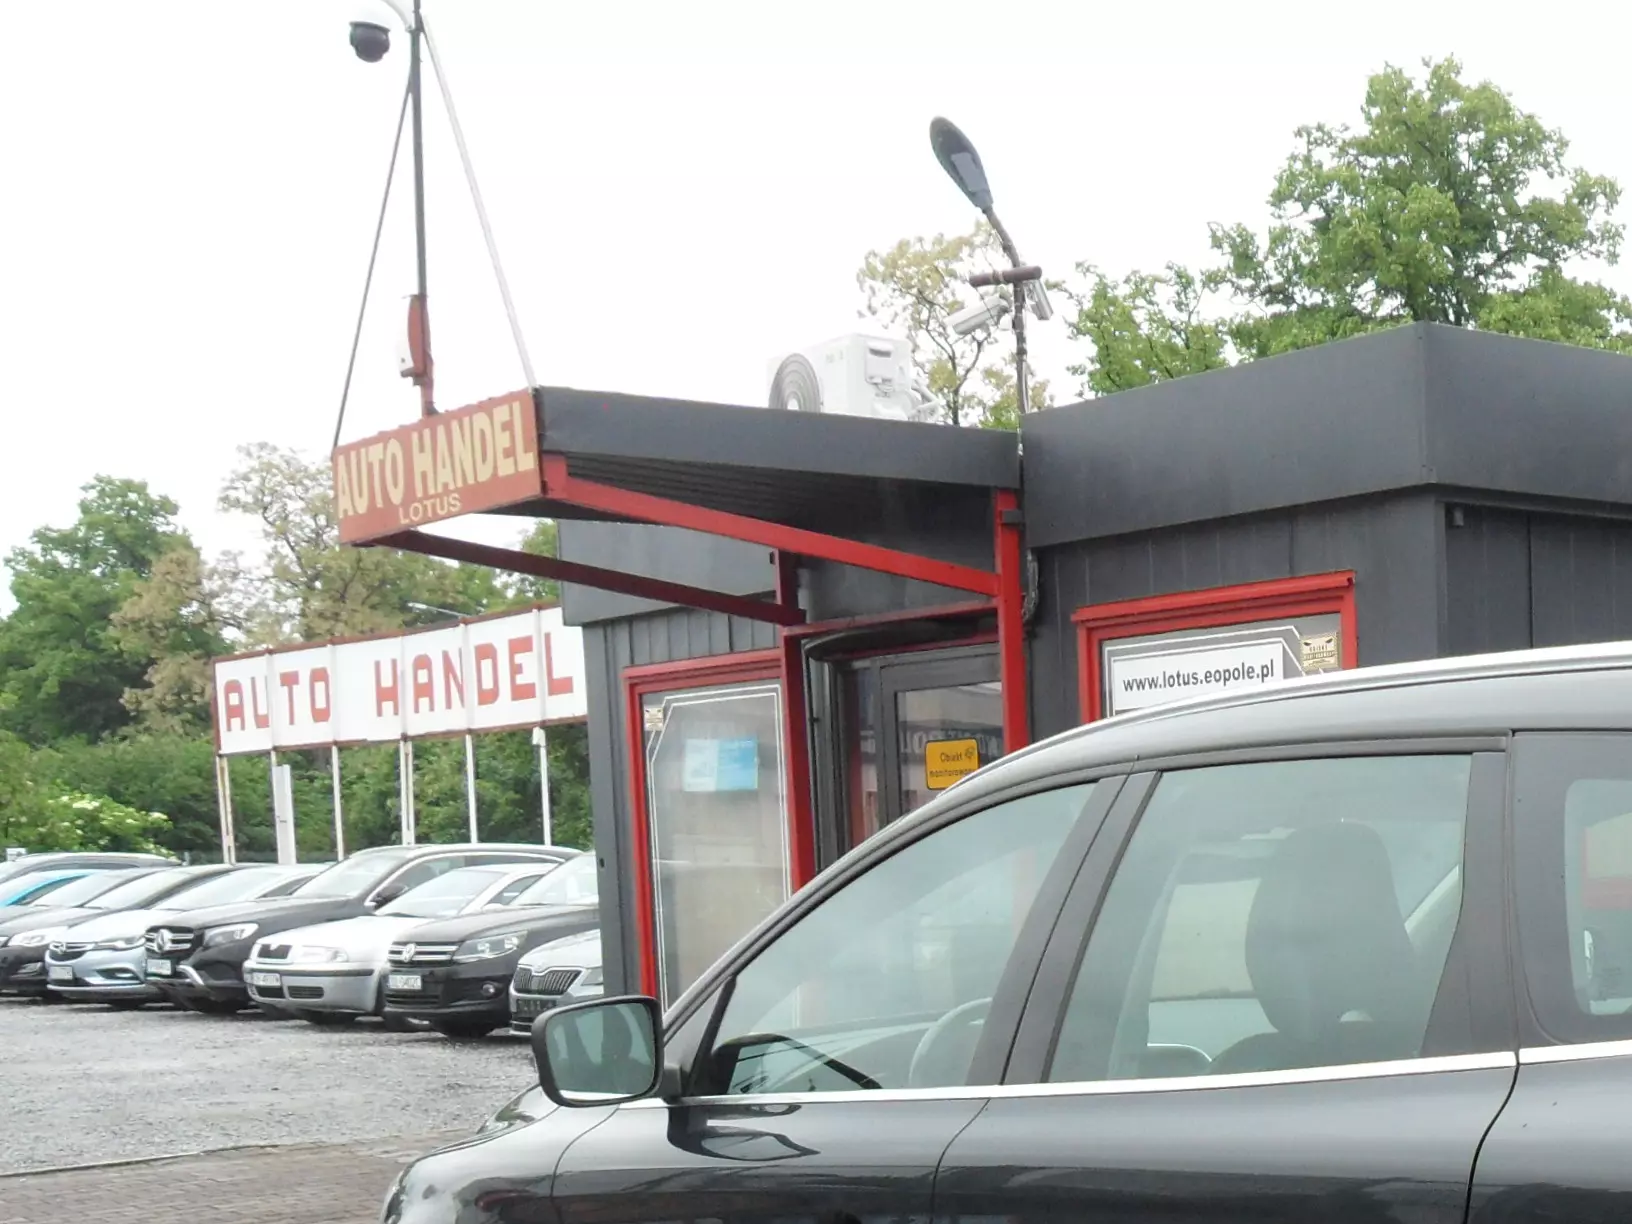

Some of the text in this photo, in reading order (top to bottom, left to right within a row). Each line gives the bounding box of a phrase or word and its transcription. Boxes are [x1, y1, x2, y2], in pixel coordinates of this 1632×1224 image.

[338, 401, 534, 519] AUTO HANDEL
[400, 493, 461, 525] LOTUS
[224, 632, 574, 732] AUTO HANDEL
[1123, 658, 1275, 692] www.lotus.eopole.pl
